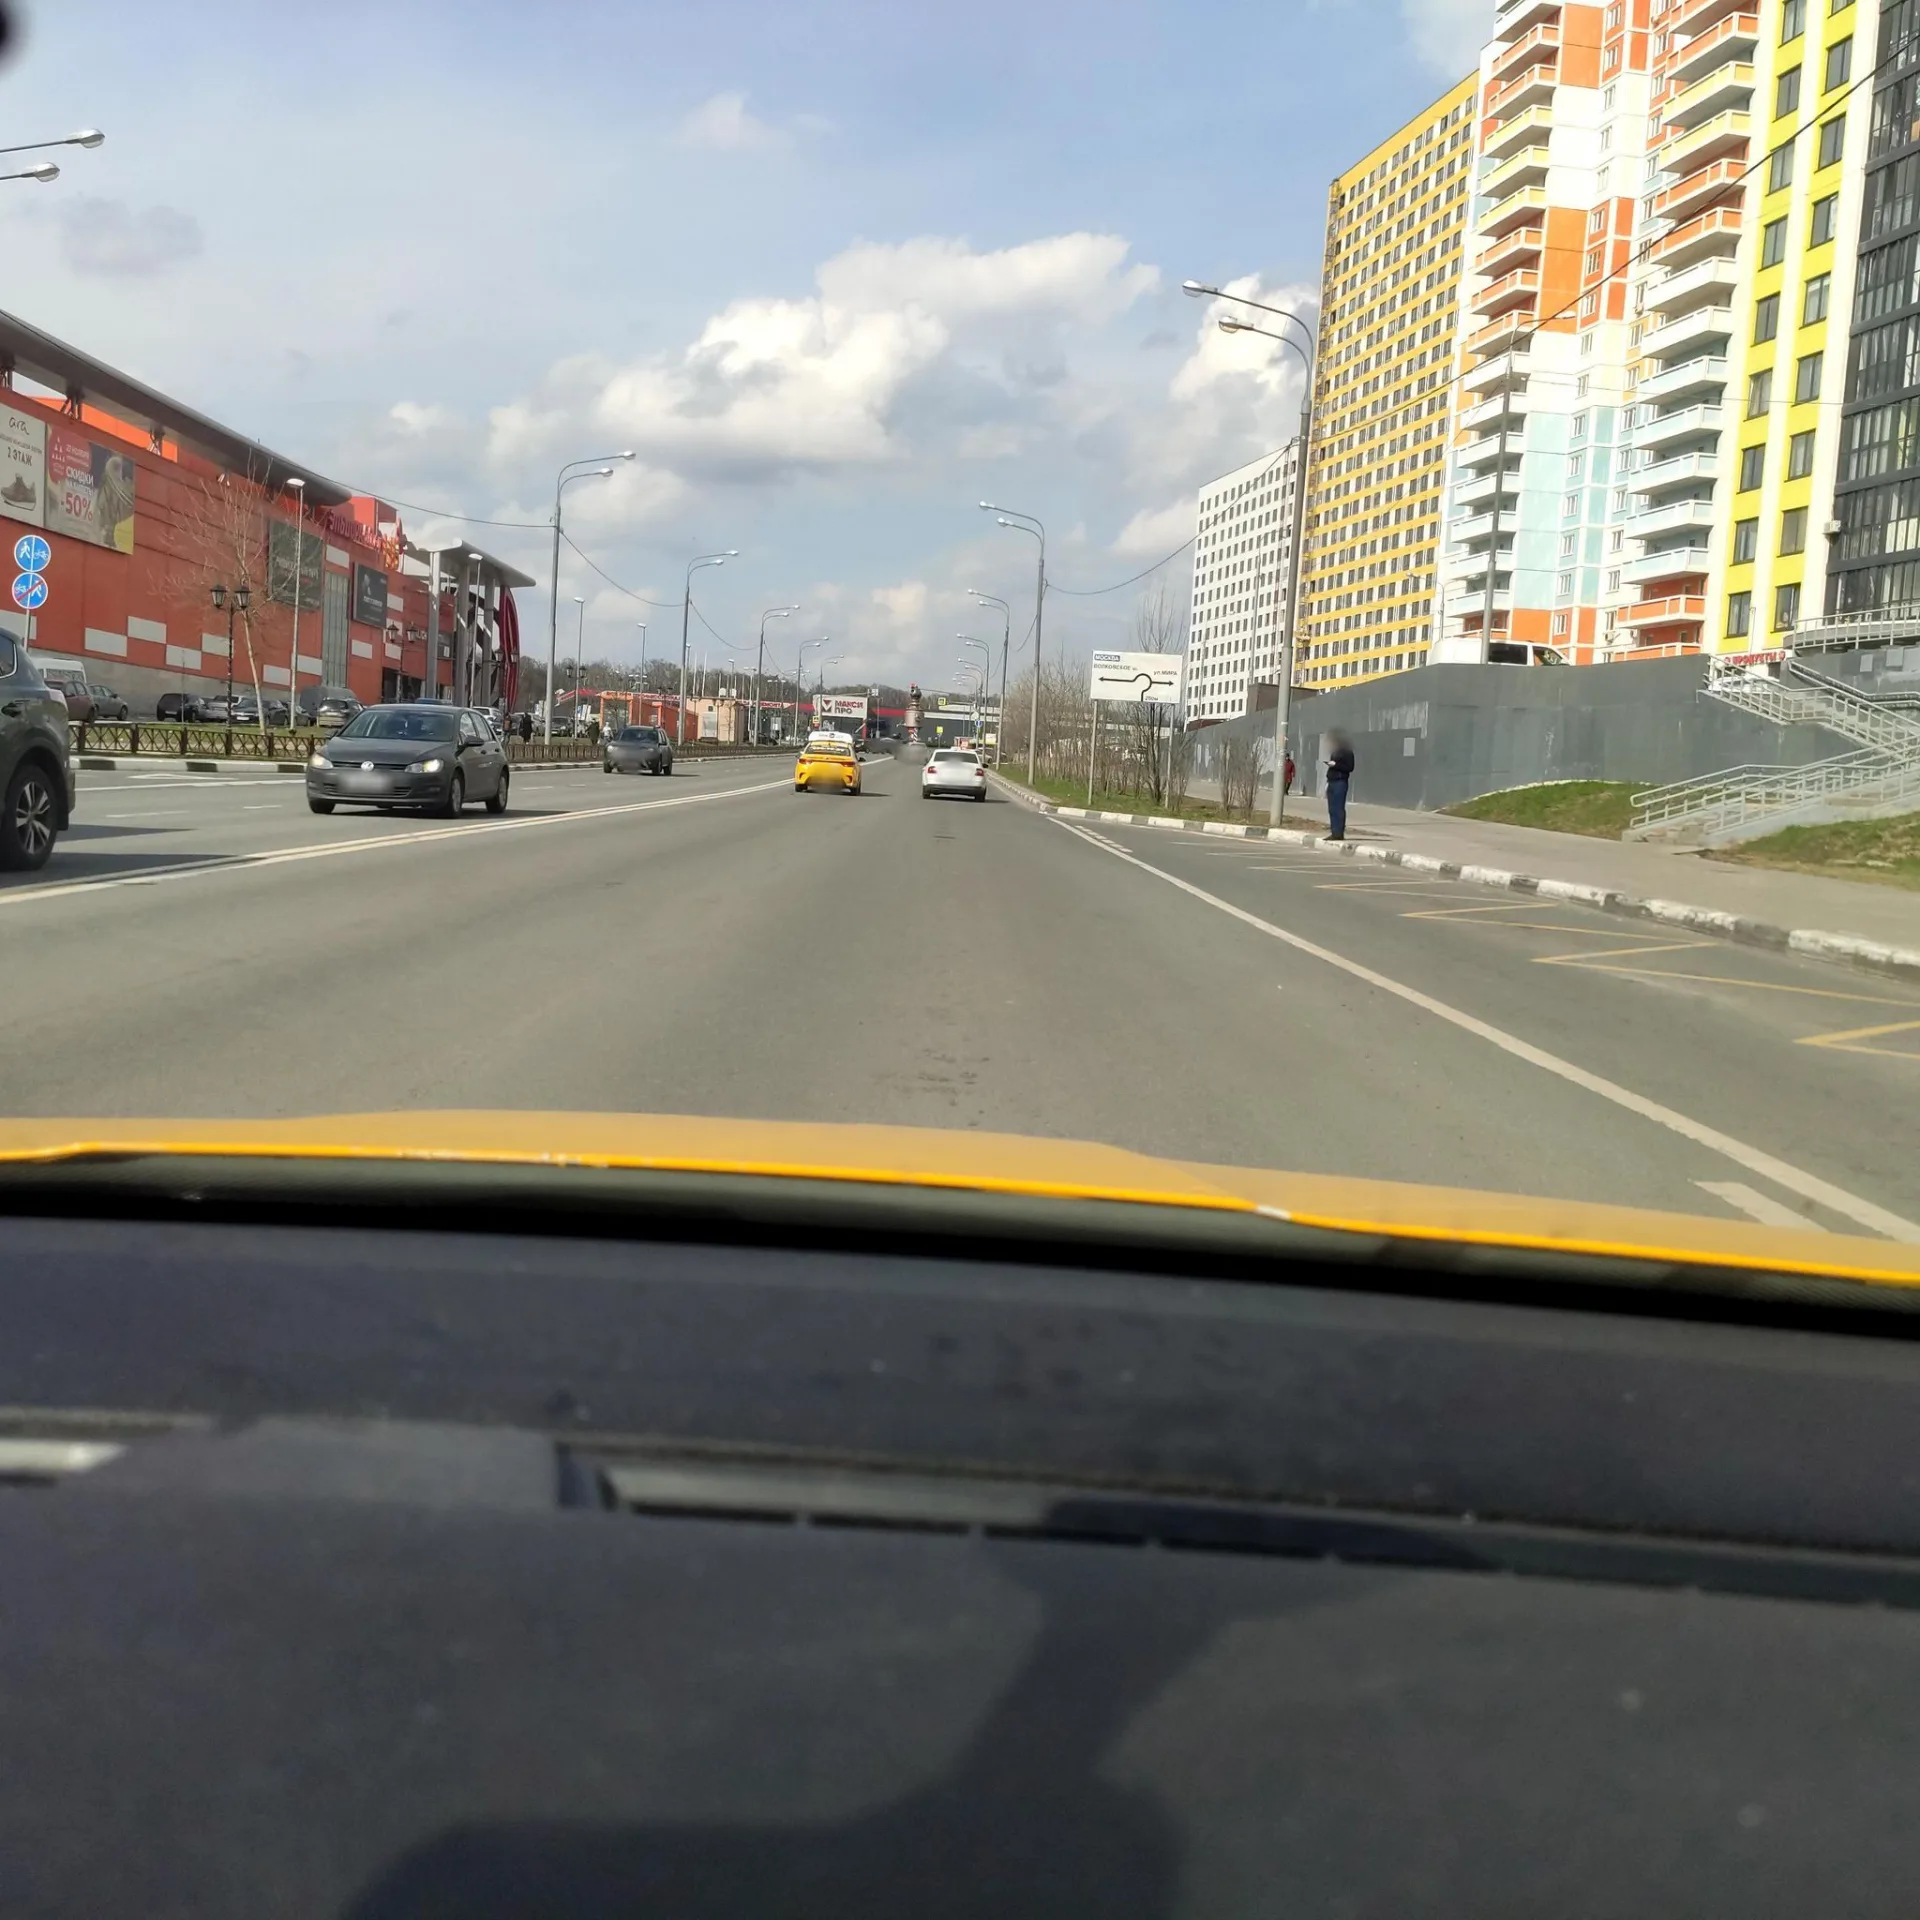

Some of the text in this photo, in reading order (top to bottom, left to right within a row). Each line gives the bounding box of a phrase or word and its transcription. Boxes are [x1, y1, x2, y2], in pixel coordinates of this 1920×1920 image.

[9, 417, 30, 436] ara
[12, 450, 33, 466] ЭТАЖ
[66, 466, 94, 486] СКИДКИ
[61, 492, 93, 521] -50%
[834, 700, 863, 708] МАКСИ
[834, 706, 852, 714] ПРО
